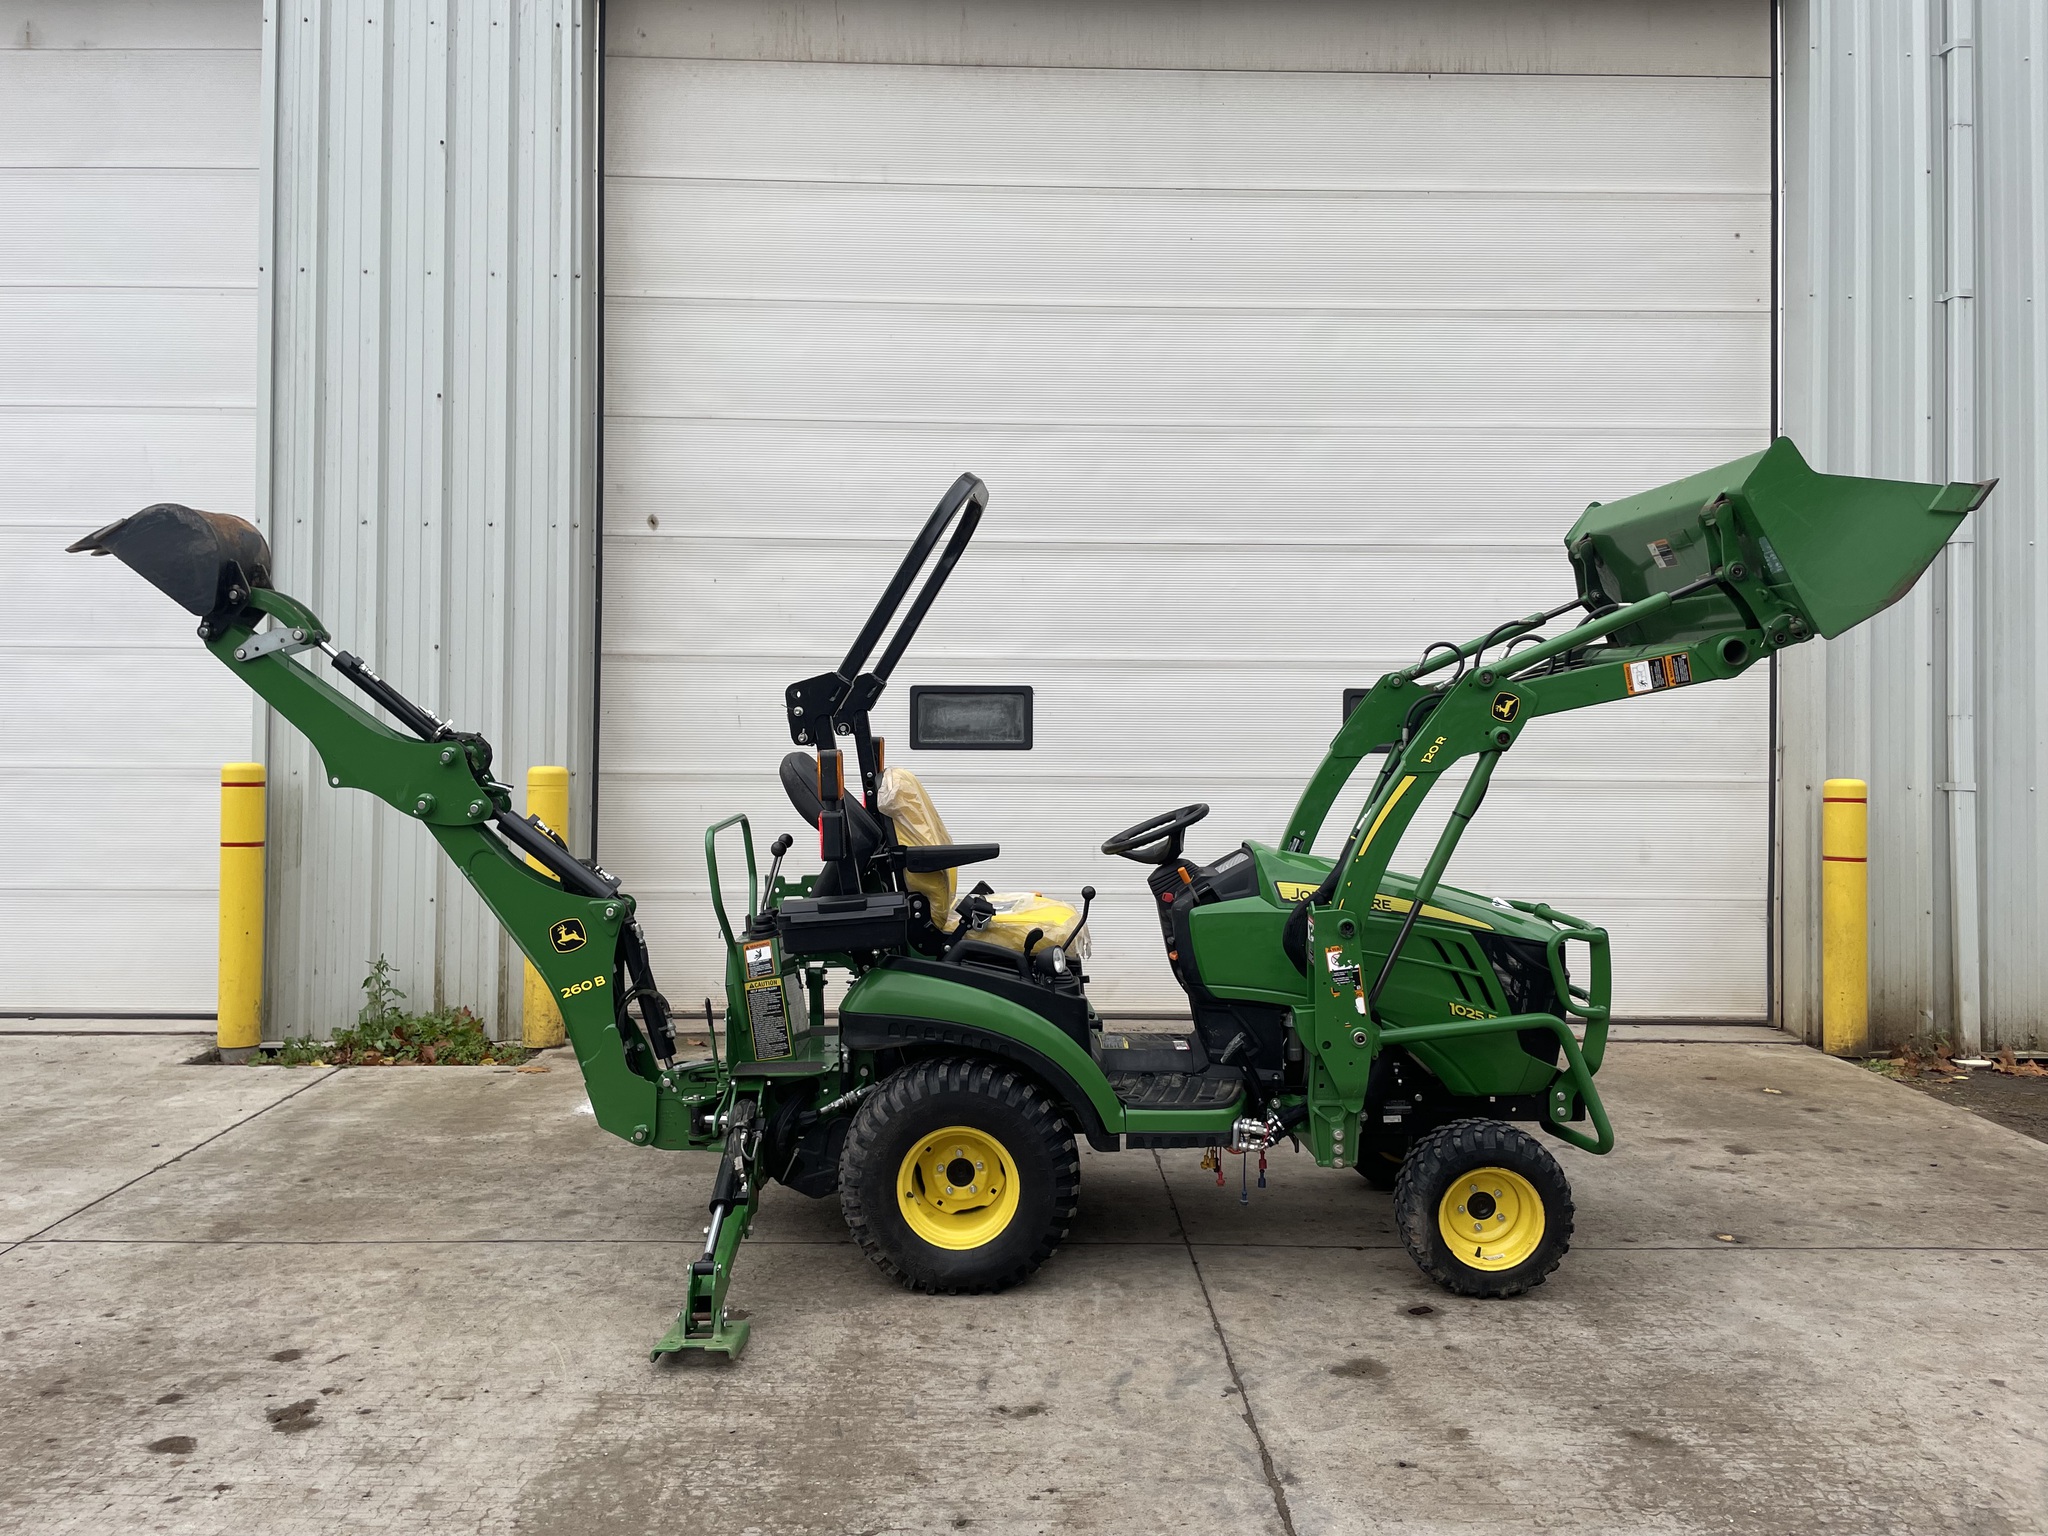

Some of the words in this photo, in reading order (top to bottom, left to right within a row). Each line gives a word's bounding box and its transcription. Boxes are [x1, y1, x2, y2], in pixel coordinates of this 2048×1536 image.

[1420, 745, 1439, 763] 120
[1435, 736, 1447, 745] R
[560, 980, 593, 999] 260
[593, 975, 606, 987] B
[754, 980, 778, 988] CAUTION
[1448, 1002, 1484, 1020] 1025
